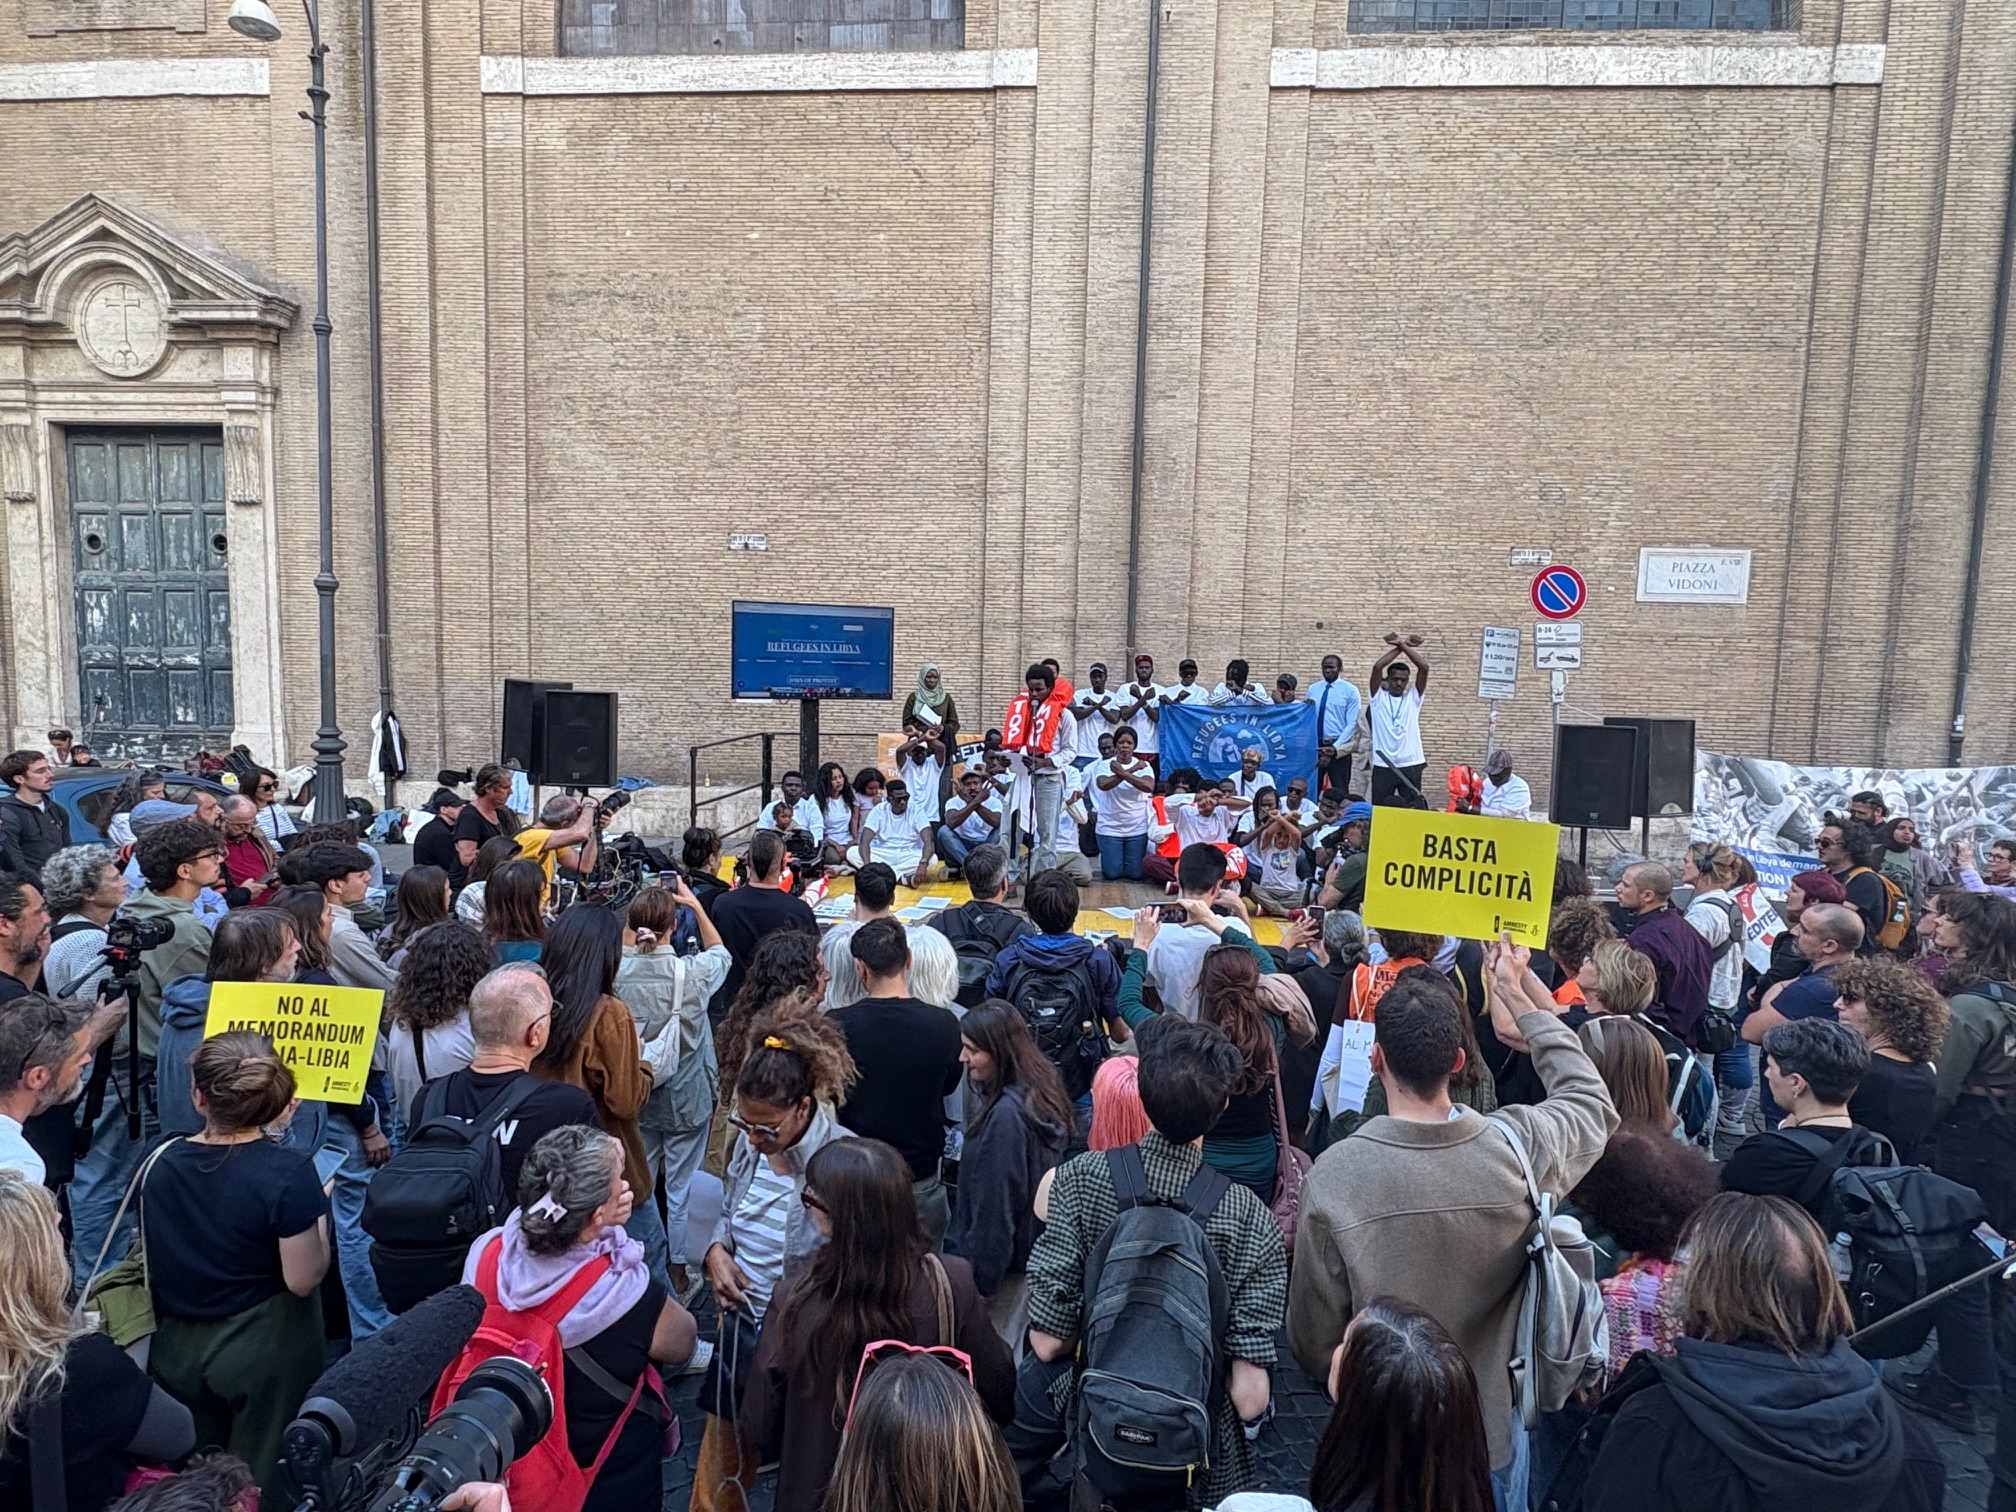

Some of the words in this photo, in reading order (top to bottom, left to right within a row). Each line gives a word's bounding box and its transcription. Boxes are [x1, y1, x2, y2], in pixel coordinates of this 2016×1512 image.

[1672, 562, 1715, 573] PIAZZA
[1668, 579, 1718, 590] VIDONI
[767, 641, 818, 652] REFUGEES
[820, 643, 830, 652] IN
[833, 644, 861, 653] LIBYA
[1007, 692, 1029, 744] TOP
[1192, 712, 1236, 759] REFUGEES
[1245, 714, 1258, 726] IN
[1262, 724, 1287, 760] LIBYA
[1423, 834, 1497, 865] BASTA
[1755, 855, 1778, 867] Libya
[1384, 861, 1532, 902] COMPLICITÀ
[1757, 870, 1785, 886] TION
[1503, 920, 1528, 930] AMNESTY
[277, 996, 303, 1015] NO
[310, 998, 331, 1017] AL
[1344, 1038, 1358, 1050] AL
[280, 1045, 350, 1069] IA-LIBIA
